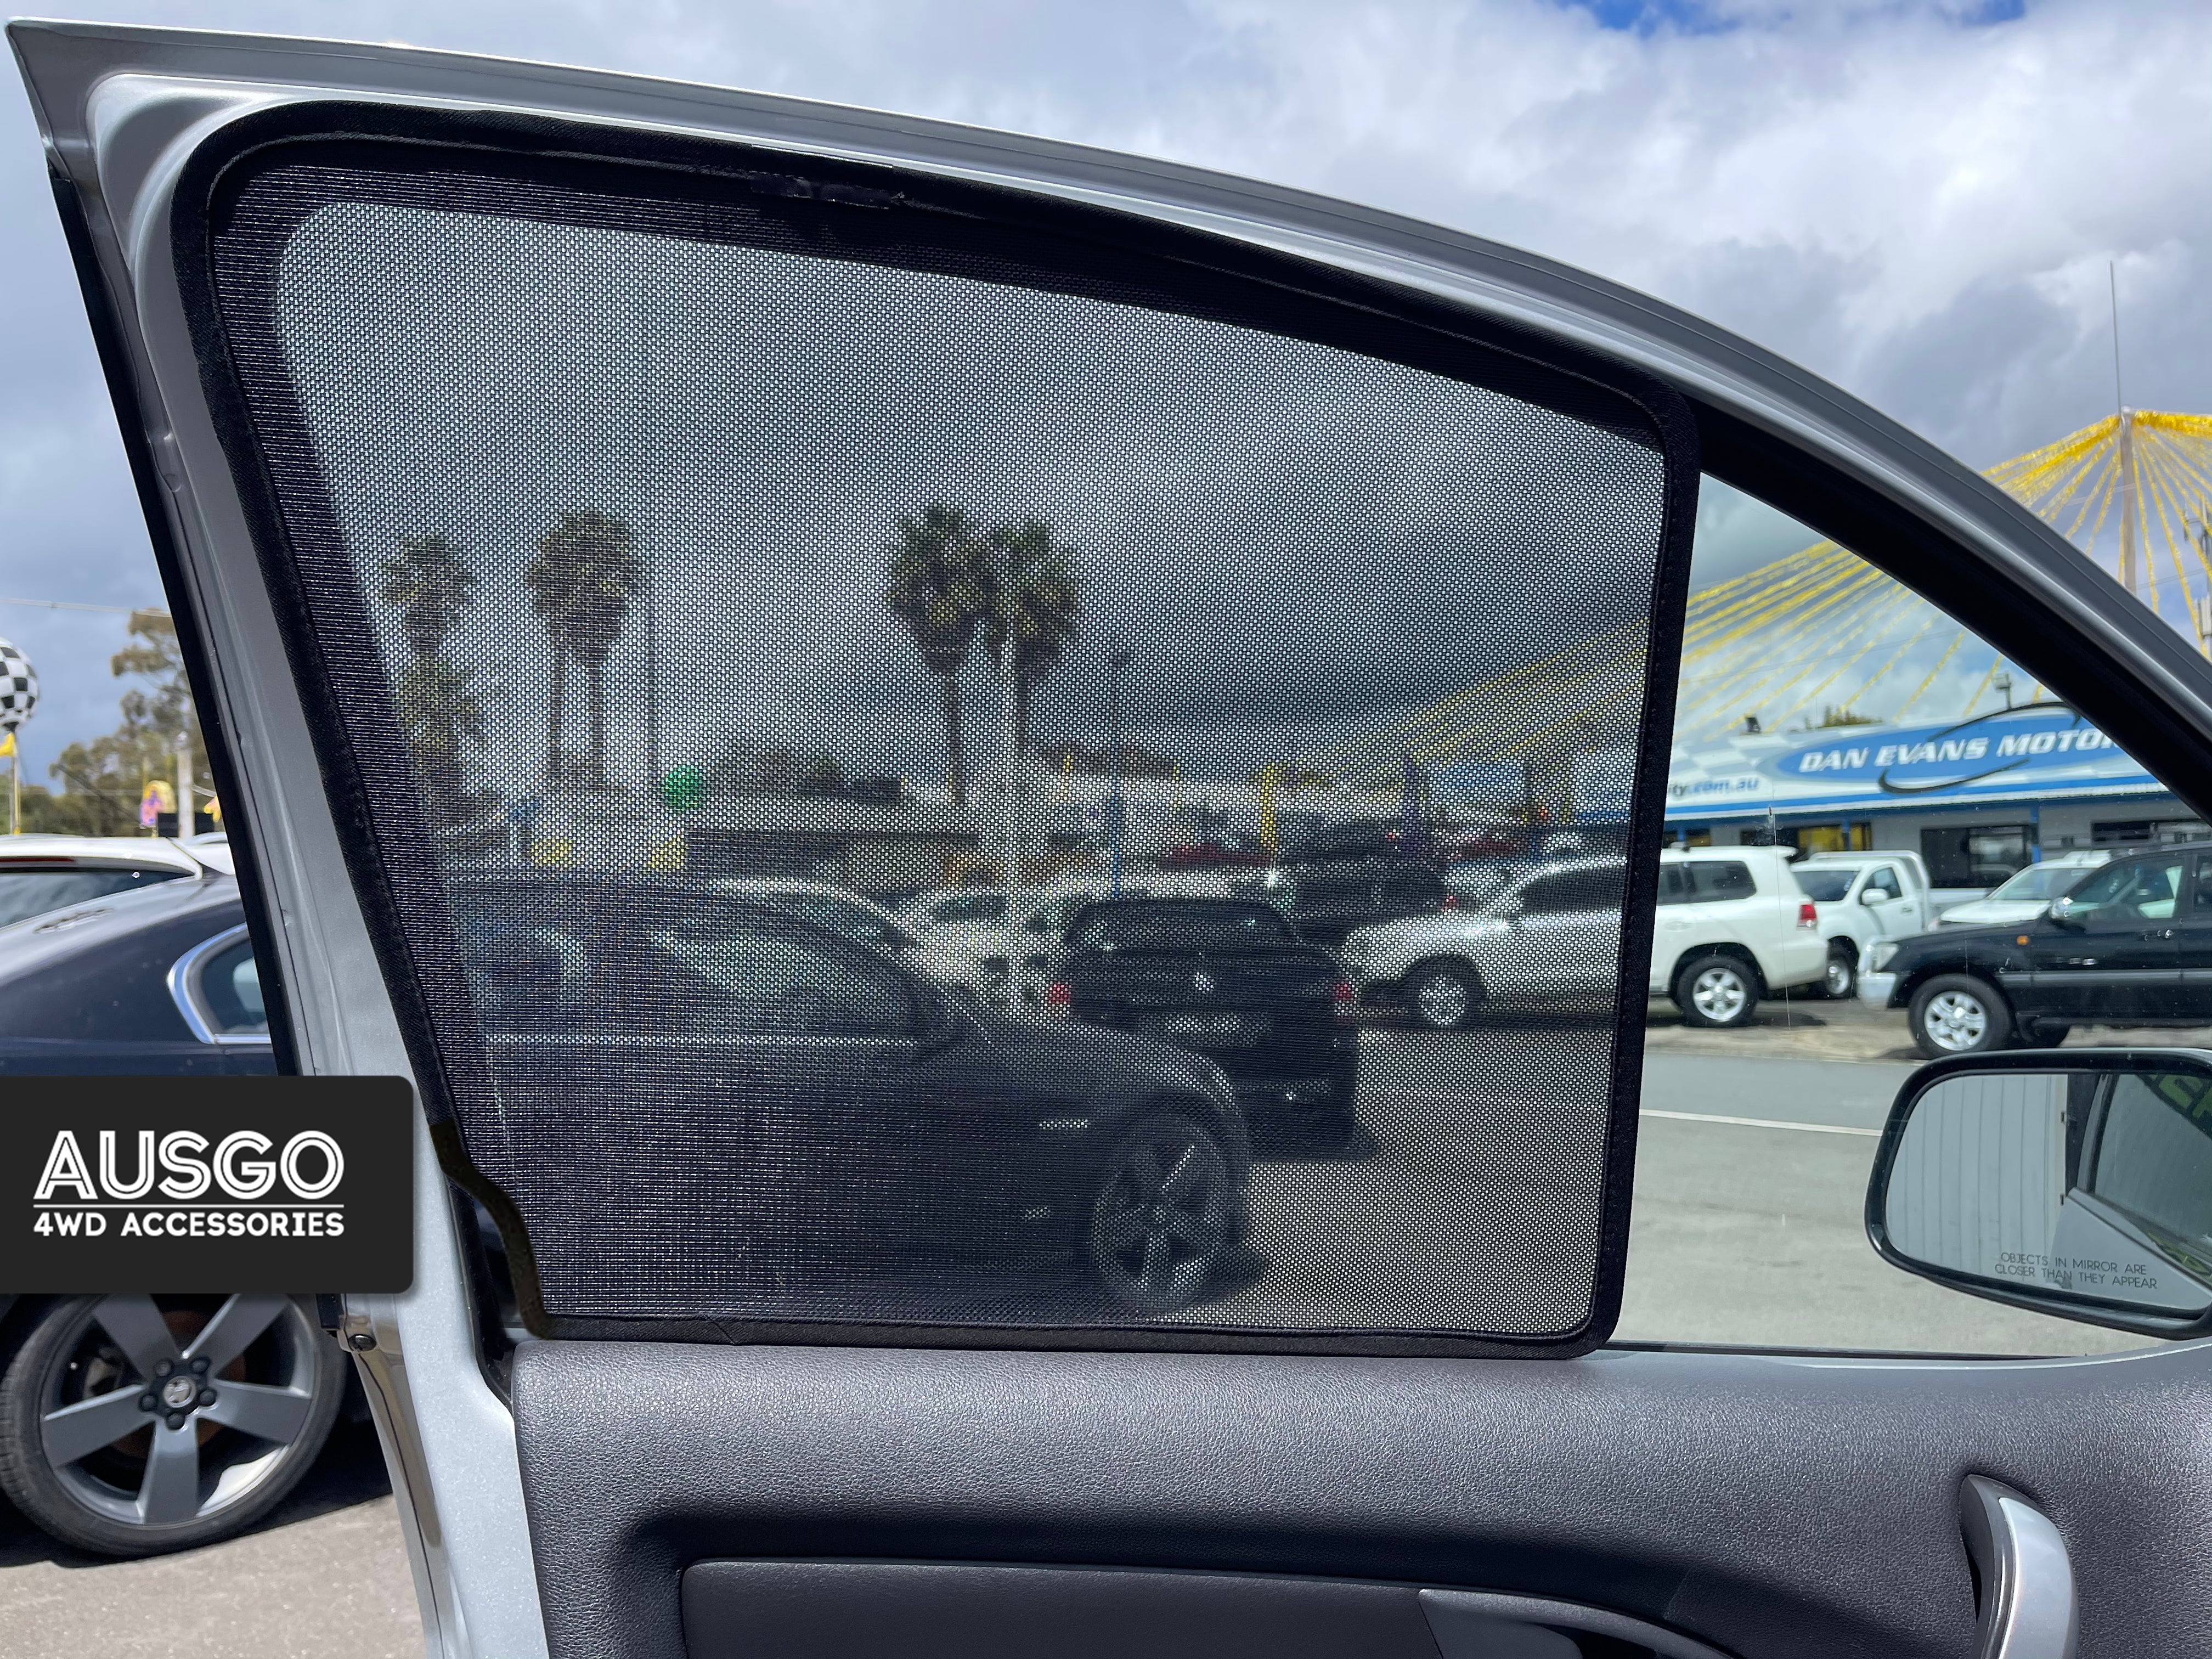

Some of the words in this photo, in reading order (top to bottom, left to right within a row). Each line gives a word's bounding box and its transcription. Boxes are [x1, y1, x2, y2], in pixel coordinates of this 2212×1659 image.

[1799, 747, 1870, 772] DAN
[1874, 737, 1990, 767] EVANS
[1995, 1263, 2035, 1277] CLOSER
[2041, 1268, 2072, 1280] THAN
[2078, 1272, 2105, 1284] THEY
[2112, 1276, 2157, 1289] APPEAR
[2000, 1251, 2049, 1266] OBJECTS
[2055, 1257, 2067, 1268] IN
[2073, 1258, 2118, 1273] MIRROR
[2125, 1263, 2147, 1276] ARE
